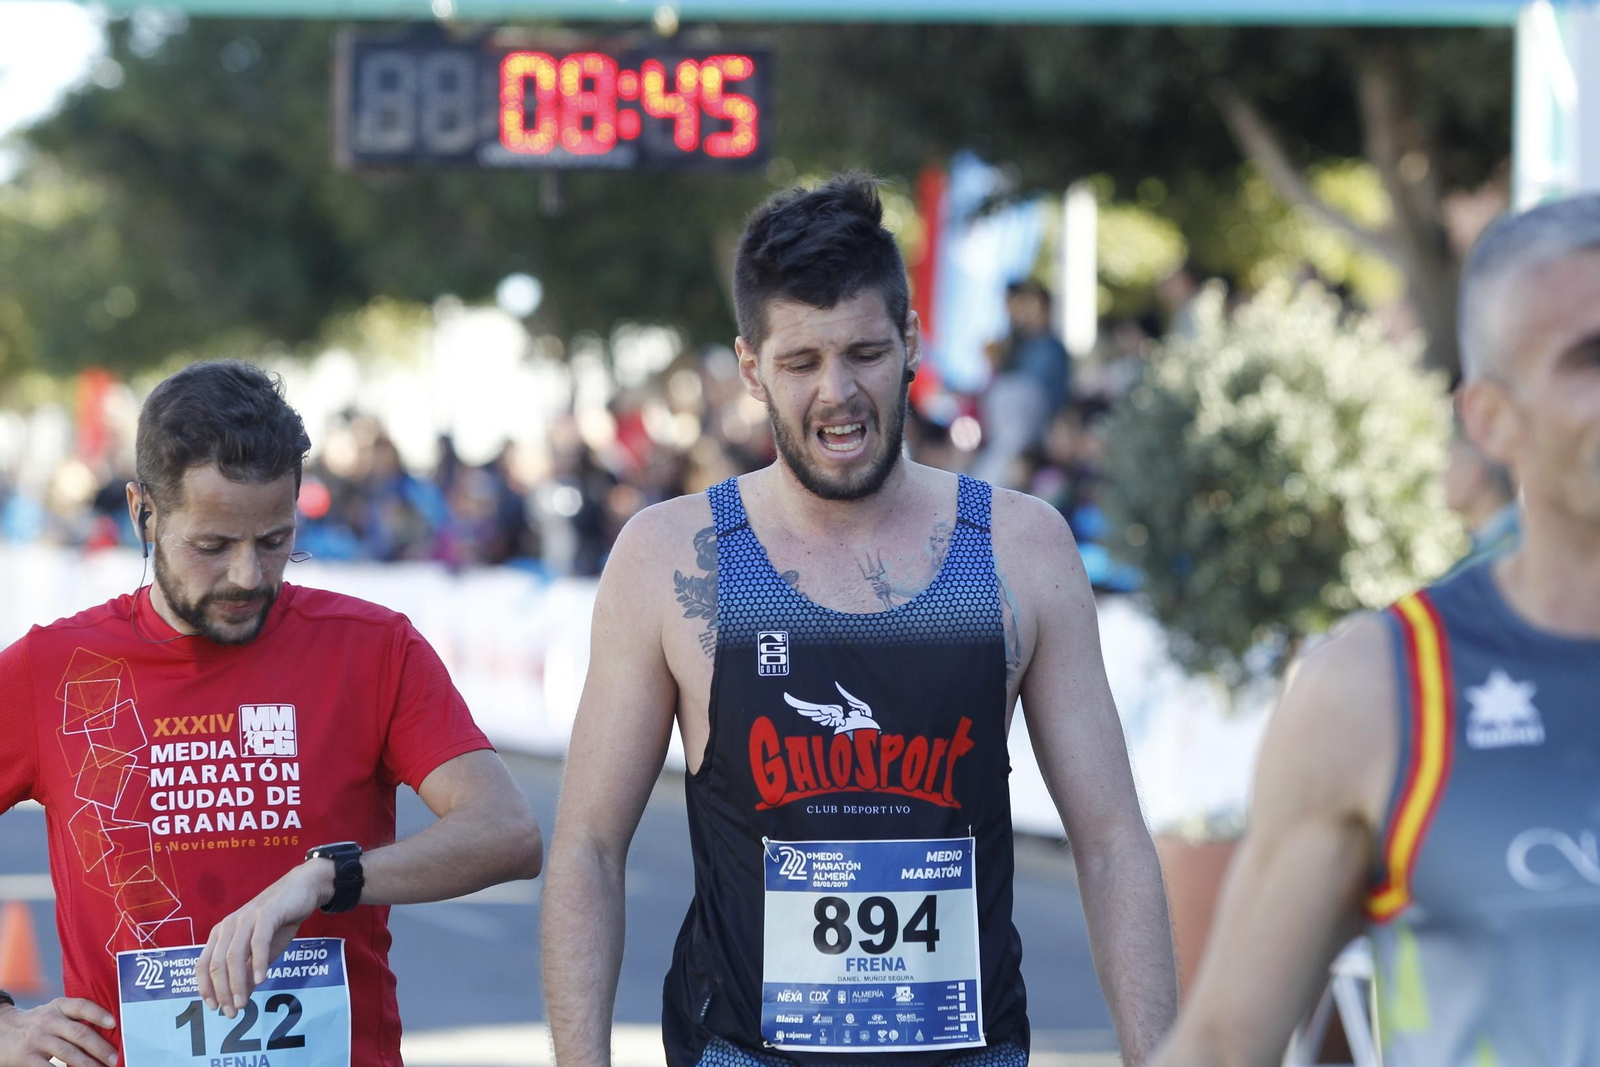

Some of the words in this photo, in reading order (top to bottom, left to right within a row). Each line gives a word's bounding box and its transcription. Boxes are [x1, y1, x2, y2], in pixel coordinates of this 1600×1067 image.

[500, 51, 758, 158] 08:45
[760, 665, 787, 674] GOBIK
[152, 713, 235, 738] XXXIV
[150, 740, 237, 764] MEDIA
[150, 759, 300, 788] MARATÓN
[150, 786, 254, 812] CIUDAD
[266, 786, 301, 806] DE
[806, 805, 838, 814] CLUB
[844, 805, 911, 814] DEPORTIVO
[151, 810, 302, 836] GRANADA
[153, 842, 162, 852] 6
[168, 837, 256, 852] Noviembre
[263, 835, 299, 847] 2016
[812, 852, 844, 861] MEDIO
[925, 850, 963, 863] MEDIO
[812, 860, 862, 871] MARATÓN
[901, 866, 962, 880] MARATÓN
[812, 871, 856, 881] ALMERÍA
[812, 895, 940, 955] 894
[283, 948, 328, 962] MEDIO
[846, 957, 907, 973] FRENA
[776, 990, 803, 1003] NEXA
[851, 989, 885, 999] ALMERÍA
[175, 993, 306, 1057] 122
